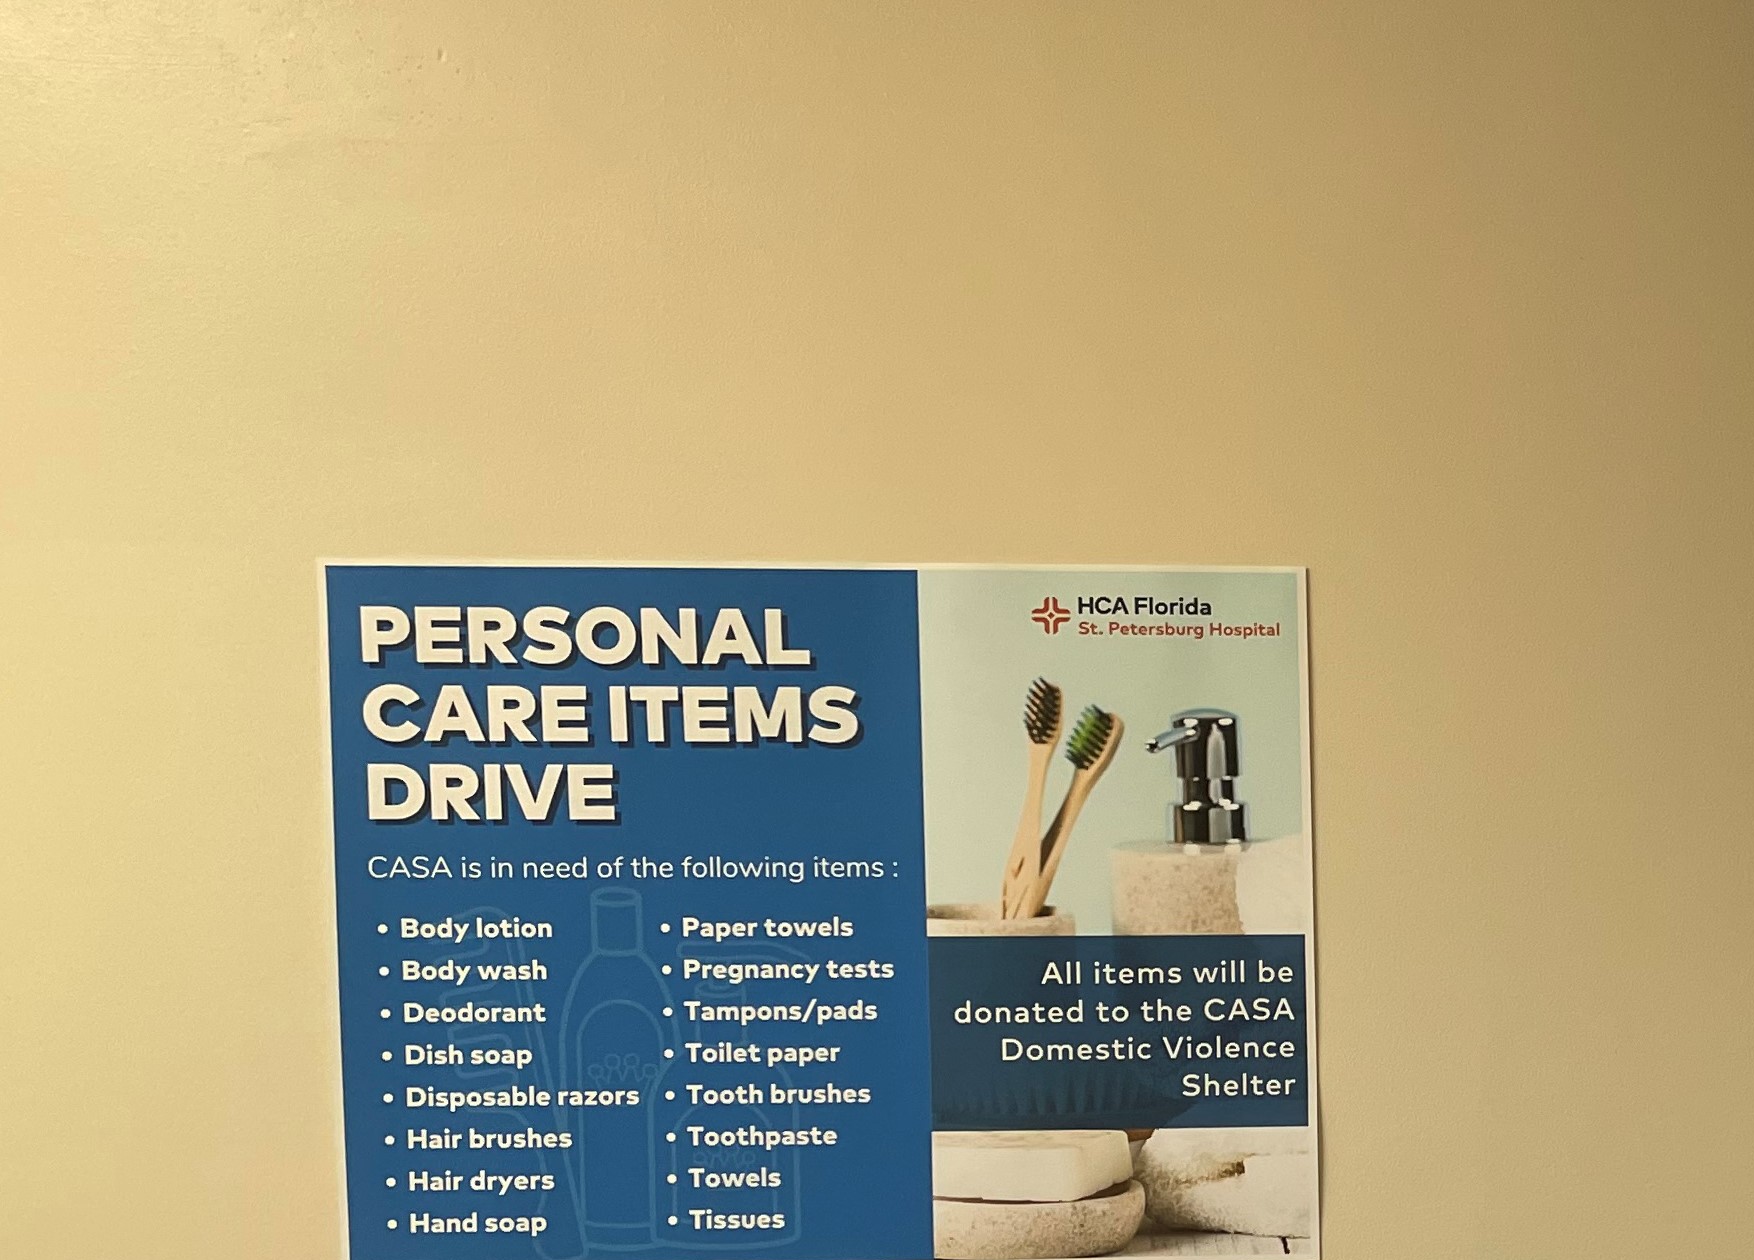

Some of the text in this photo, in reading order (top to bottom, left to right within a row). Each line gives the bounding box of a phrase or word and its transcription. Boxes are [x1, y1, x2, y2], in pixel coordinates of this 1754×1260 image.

[1078, 597, 1211, 615] HCA Florida
[360, 606, 810, 664] PERSONAL
[1079, 622, 1279, 639] St. Petersburg Hospital
[363, 684, 858, 743] CARE ITEMS
[367, 764, 615, 820] DRIVE
[369, 856, 883, 882] CASA is in need of the following items
[401, 917, 552, 943] Body lotion
[683, 917, 853, 942] Paper towels
[402, 960, 547, 985] Body wash
[684, 959, 894, 984] Pregnancy tests
[1042, 960, 1293, 984] All items will be
[404, 1002, 546, 1022] Deodorant
[684, 999, 877, 1025] Tampons/pads
[955, 998, 1294, 1023] donated to the CASA
[406, 1044, 532, 1069] Dish soap
[685, 1042, 840, 1067] Toilet paper
[1002, 1036, 1294, 1060] Domestic Violence
[686, 1083, 870, 1104] Tooth brushes
[1183, 1073, 1295, 1096] Shelter
[407, 1086, 639, 1112] Disposable razors
[408, 1128, 572, 1149] Hair brushes
[687, 1126, 837, 1150] Toothpaste
[409, 1170, 554, 1195] Hair dryers
[688, 1167, 781, 1187] Towels
[410, 1212, 546, 1236] Hand soap
[689, 1209, 785, 1229] Tissues
